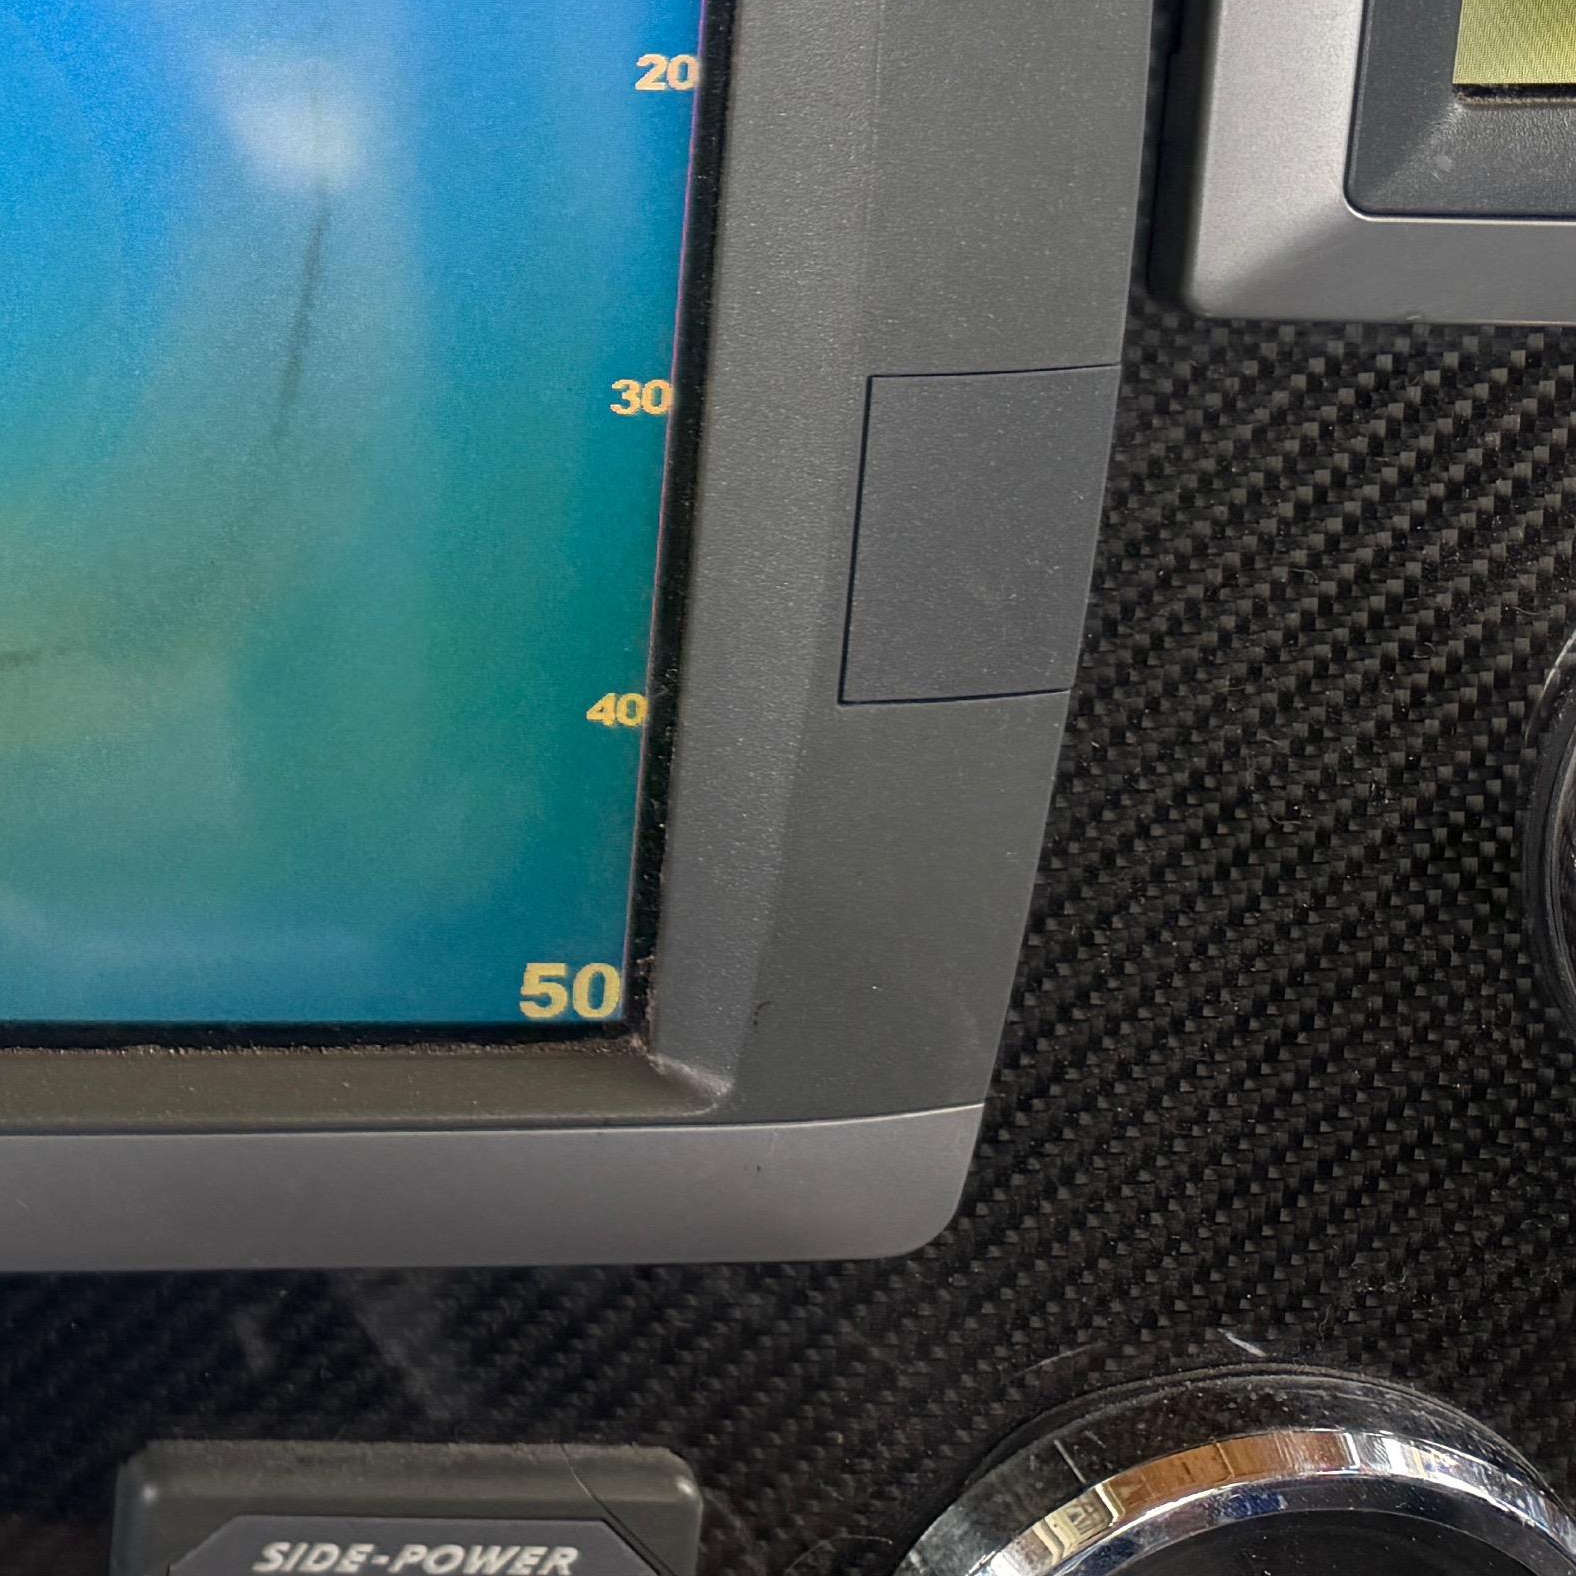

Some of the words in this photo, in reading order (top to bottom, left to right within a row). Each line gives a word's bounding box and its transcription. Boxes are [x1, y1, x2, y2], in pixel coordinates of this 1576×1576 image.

[635, 54, 700, 91] 20
[609, 379, 673, 416] 30
[586, 692, 648, 727] 40
[519, 962, 621, 1019] 50
[252, 1541, 580, 1575] SIDE-POWER
